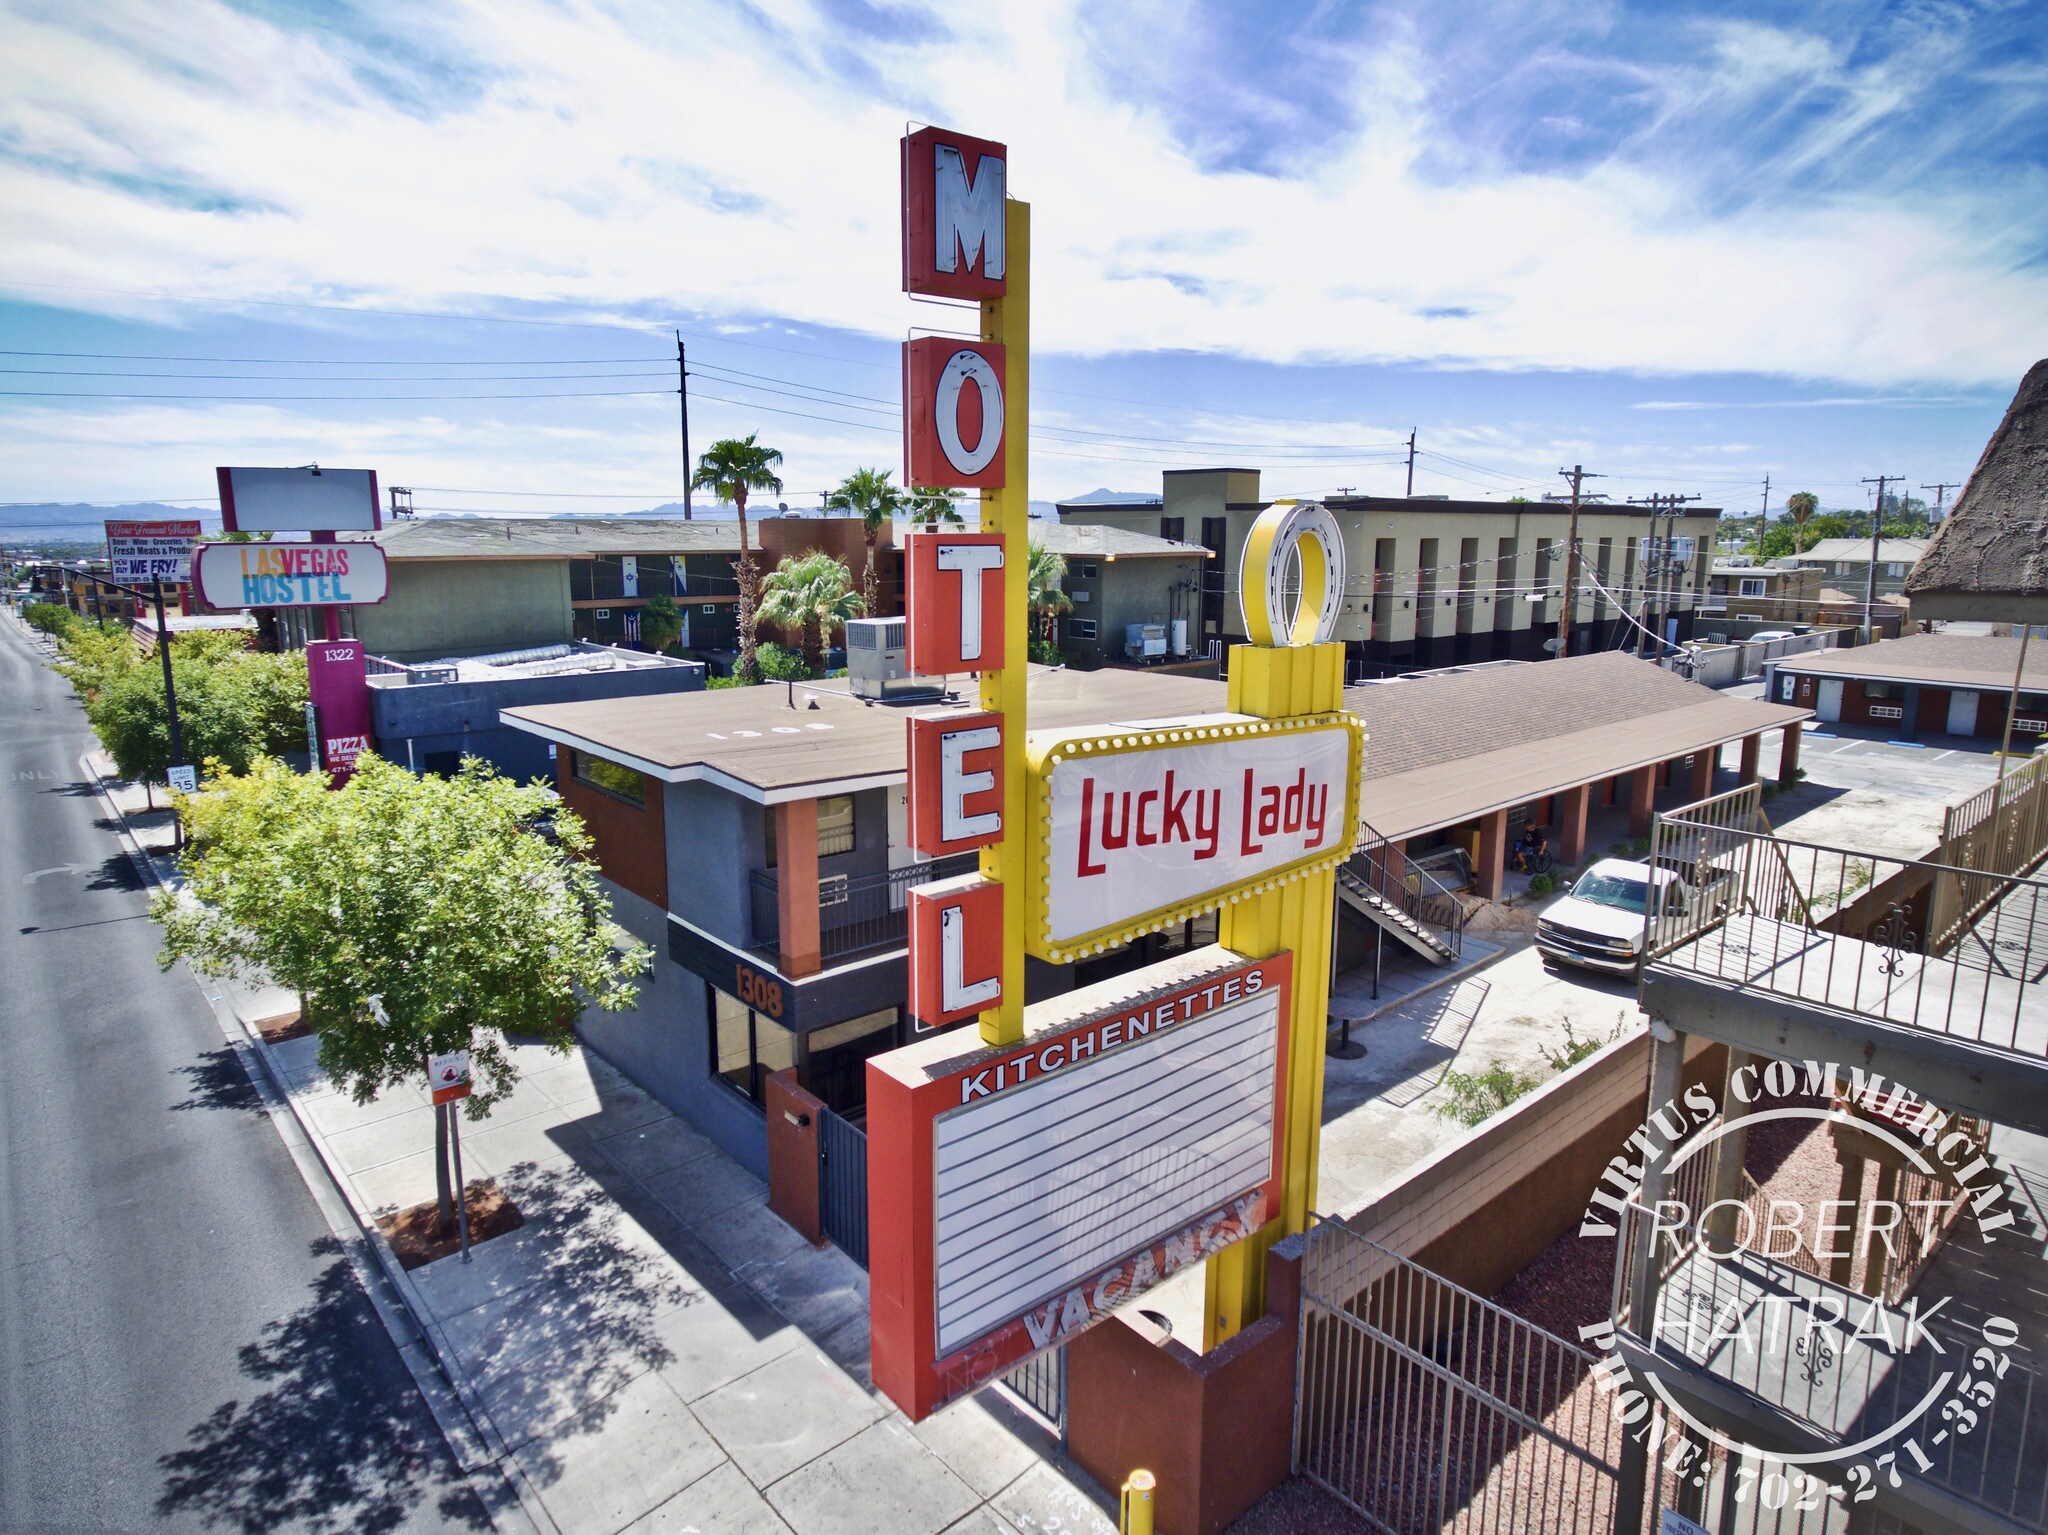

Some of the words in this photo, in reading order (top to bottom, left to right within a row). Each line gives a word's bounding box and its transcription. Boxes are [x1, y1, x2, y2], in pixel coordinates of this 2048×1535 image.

[111, 524, 133, 536] Your
[168, 523, 198, 534] Market
[113, 547, 135, 555] Fresh
[137, 546, 160, 555] Meats
[162, 547, 167, 555] &
[130, 560, 147, 574] WE
[151, 559, 178, 574] FRY!
[934, 144, 1004, 1014] MOTEL
[242, 571, 352, 604] HOSTEL
[324, 648, 354, 661] 1322
[327, 735, 369, 755] PIZZA
[1077, 769, 1221, 878] Lucky
[1240, 767, 1328, 857] Lady
[736, 963, 784, 1017] 1308
[961, 969, 1264, 1105] KITCHENETTES
[1022, 1189, 1265, 1351] VACANCY
[1678, 1521, 1694, 1535] NO
